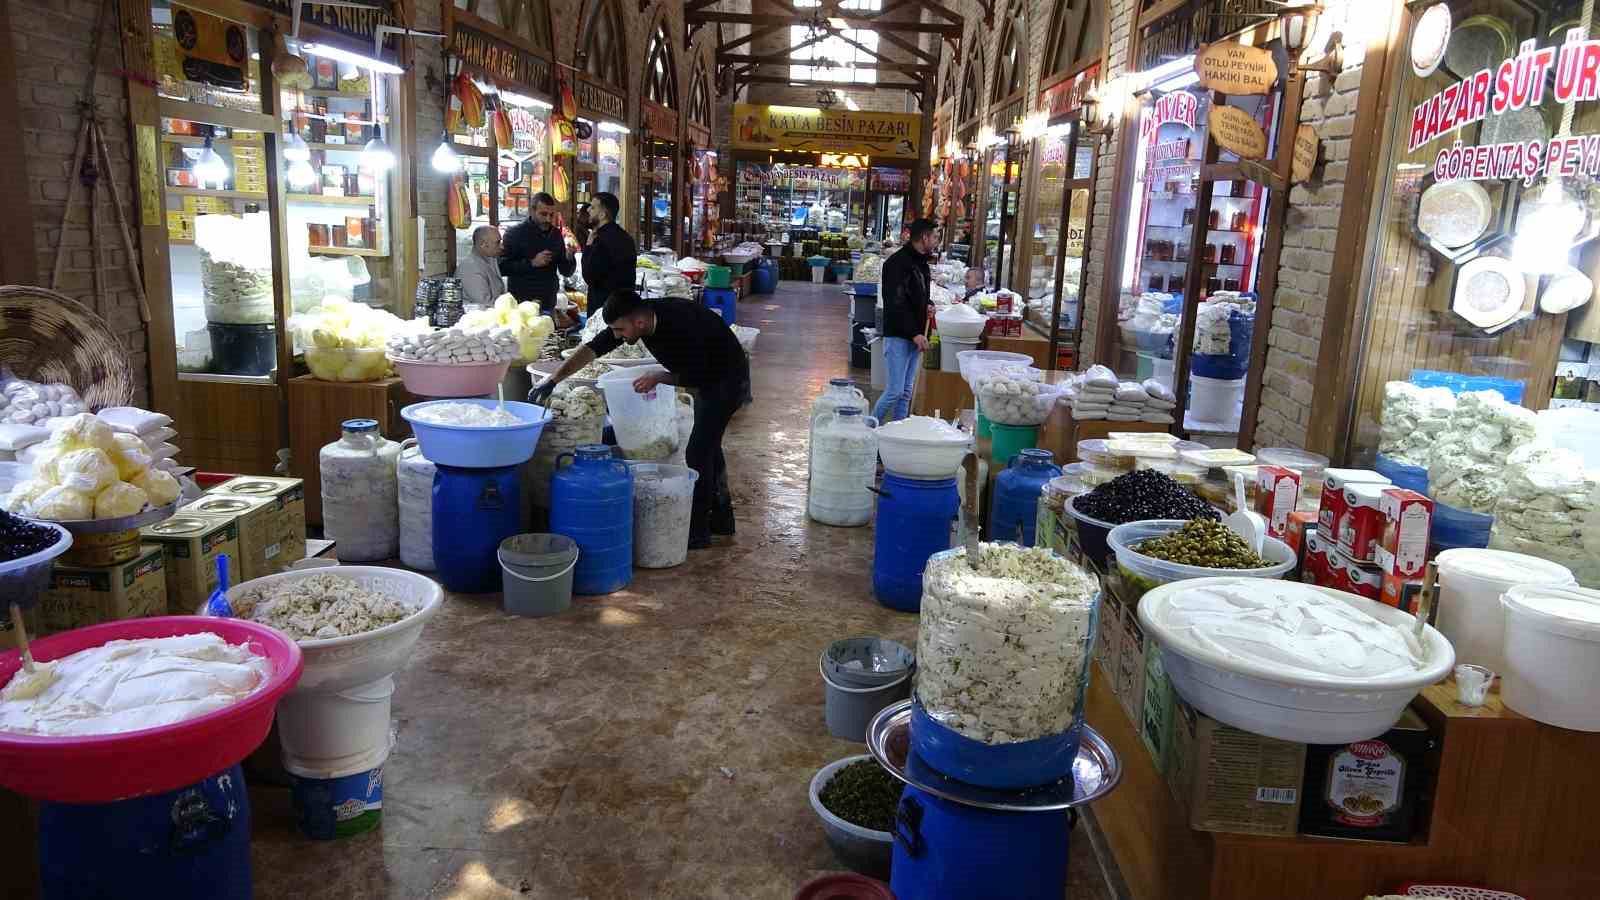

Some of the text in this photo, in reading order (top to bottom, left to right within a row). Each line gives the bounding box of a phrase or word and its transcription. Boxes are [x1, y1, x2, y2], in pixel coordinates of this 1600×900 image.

[1227, 50, 1246, 59] VAN
[1204, 57, 1267, 73] OTLU PEYNİRİ
[1204, 69, 1265, 85] HAKİKİ BAL
[1408, 69, 1491, 153] HAZAR
[1492, 38, 1556, 115] SÜT
[1554, 27, 1600, 103] ÜR
[769, 114, 912, 137] KAYA BESİN PAZARI
[1434, 139, 1541, 188] GÖRENTAŞ
